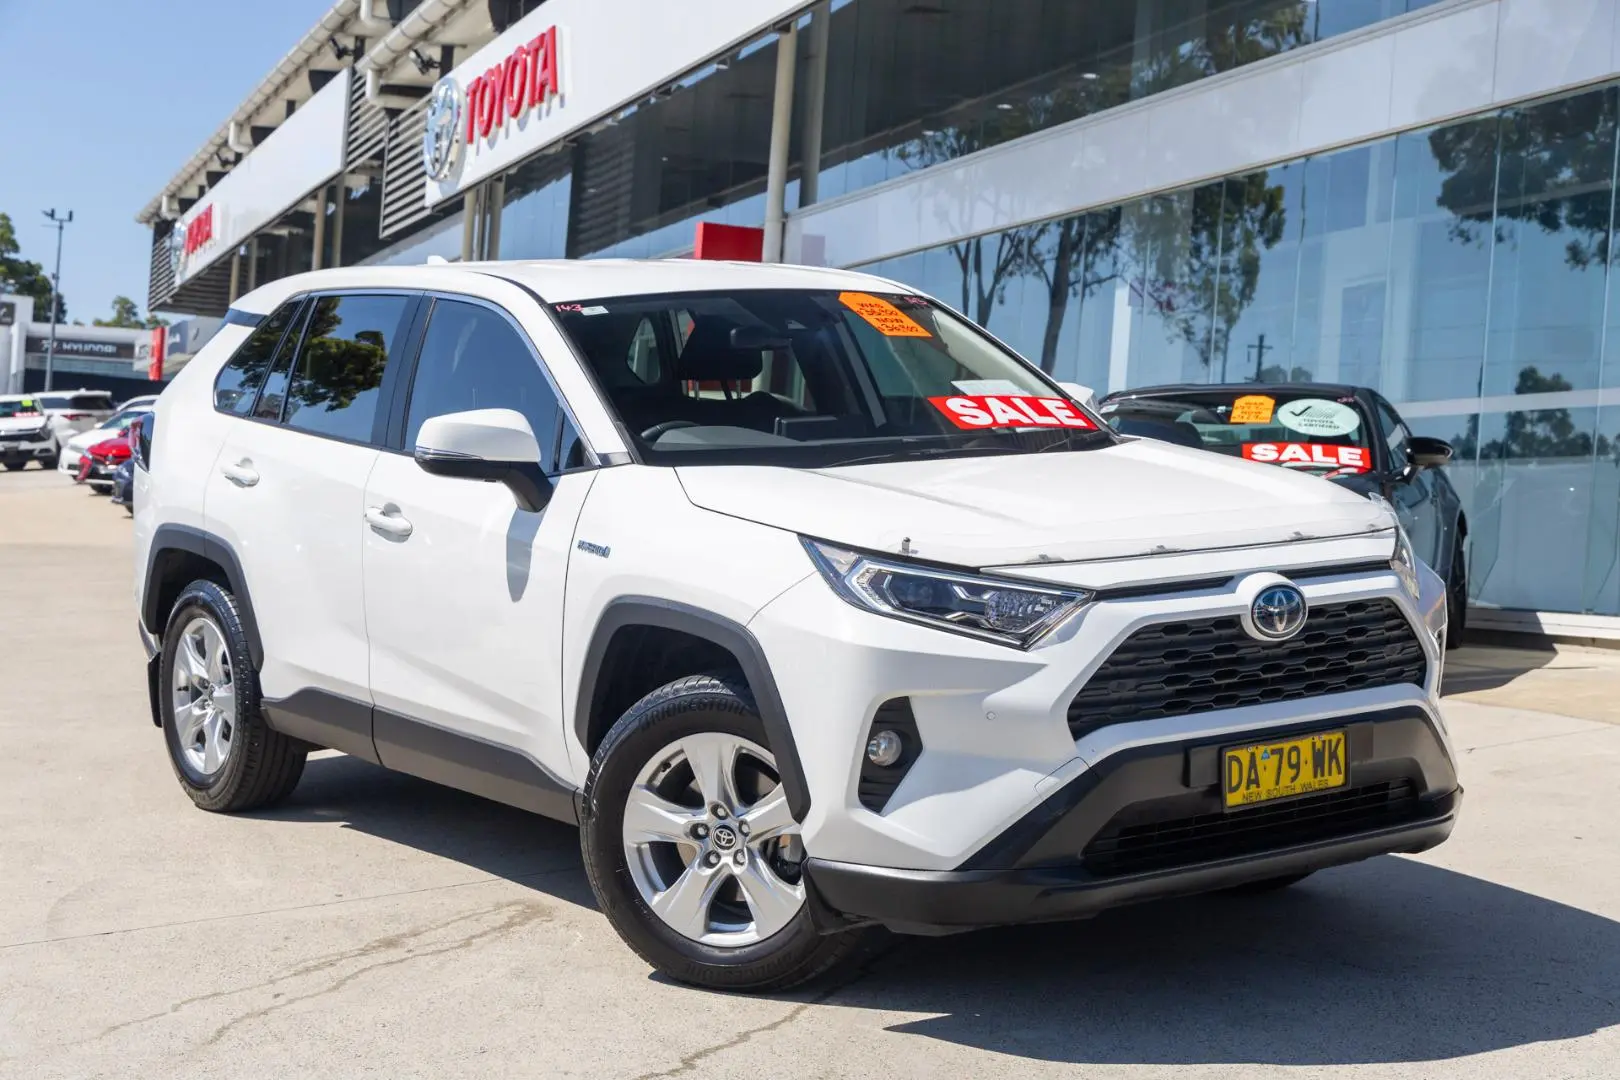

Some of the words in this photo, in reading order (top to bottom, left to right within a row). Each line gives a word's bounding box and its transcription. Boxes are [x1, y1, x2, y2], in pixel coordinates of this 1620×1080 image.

[466, 25, 558, 145] TOYOTA
[946, 396, 1088, 427] SALE
[1251, 443, 1364, 467] SALE
[1242, 790, 1263, 803] NEW
[1266, 784, 1296, 799] SOUTH
[1300, 778, 1329, 793] WALES
